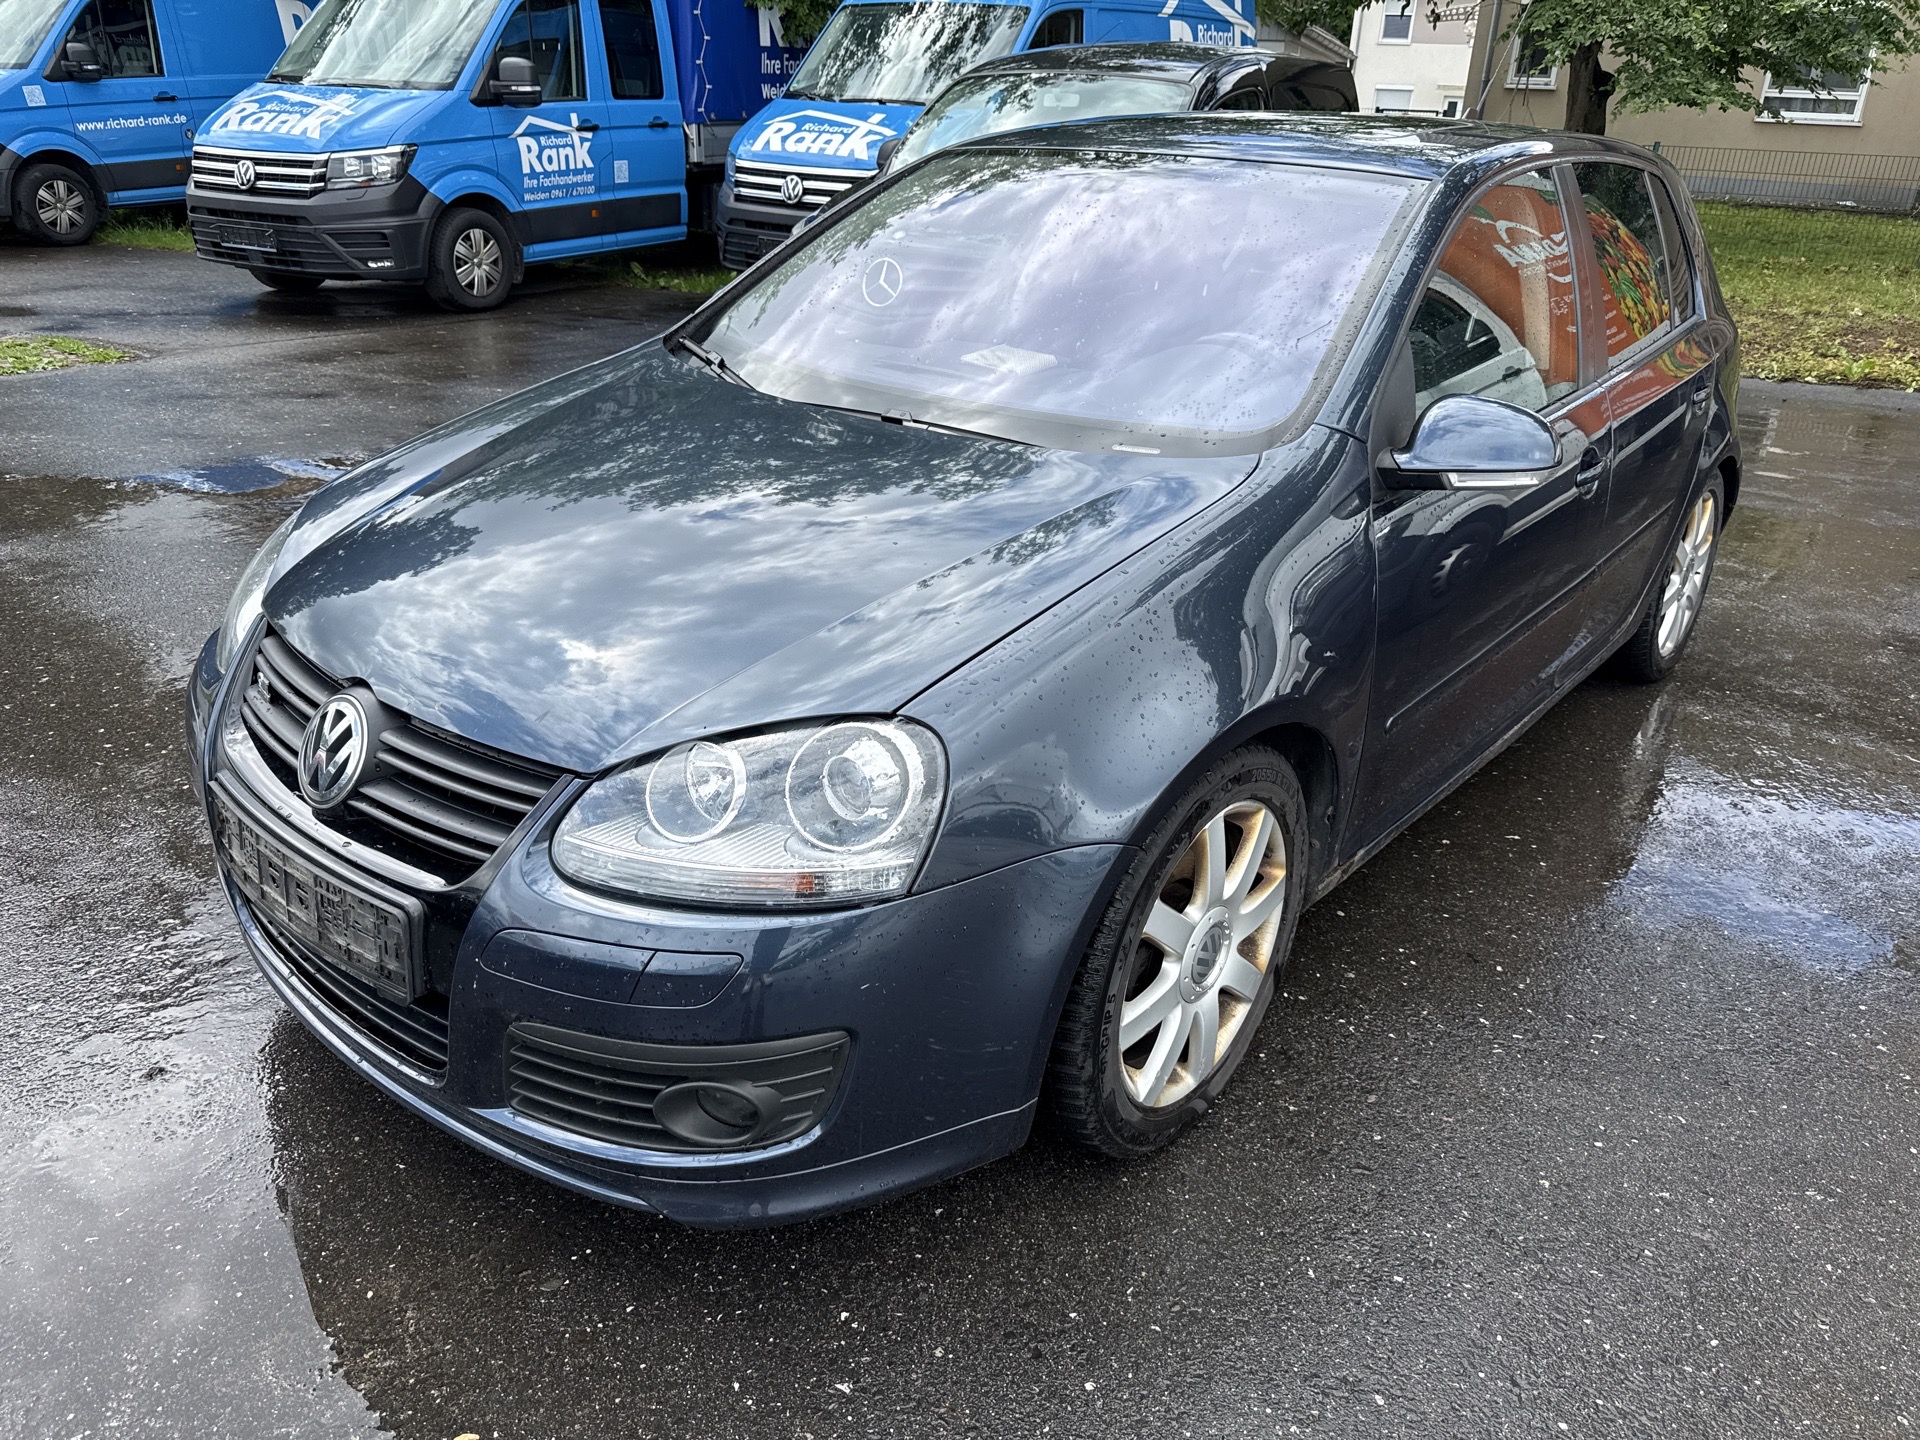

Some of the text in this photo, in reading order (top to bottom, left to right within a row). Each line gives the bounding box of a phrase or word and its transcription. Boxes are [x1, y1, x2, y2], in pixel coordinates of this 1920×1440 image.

[1198, 23, 1233, 46] Richard
[761, 52, 781, 75] Ihre
[263, 101, 315, 114] Richard
[76, 113, 187, 131] www.richard-rank.de
[210, 99, 340, 139] Rank
[802, 122, 858, 134] Richard
[540, 134, 573, 146] Richard
[751, 118, 886, 160] Rank
[517, 125, 594, 174] Rank
[524, 170, 595, 189] Ihre Fachhandwerker
[523, 191, 550, 201] Weiden
[550, 188, 566, 199] 0961
